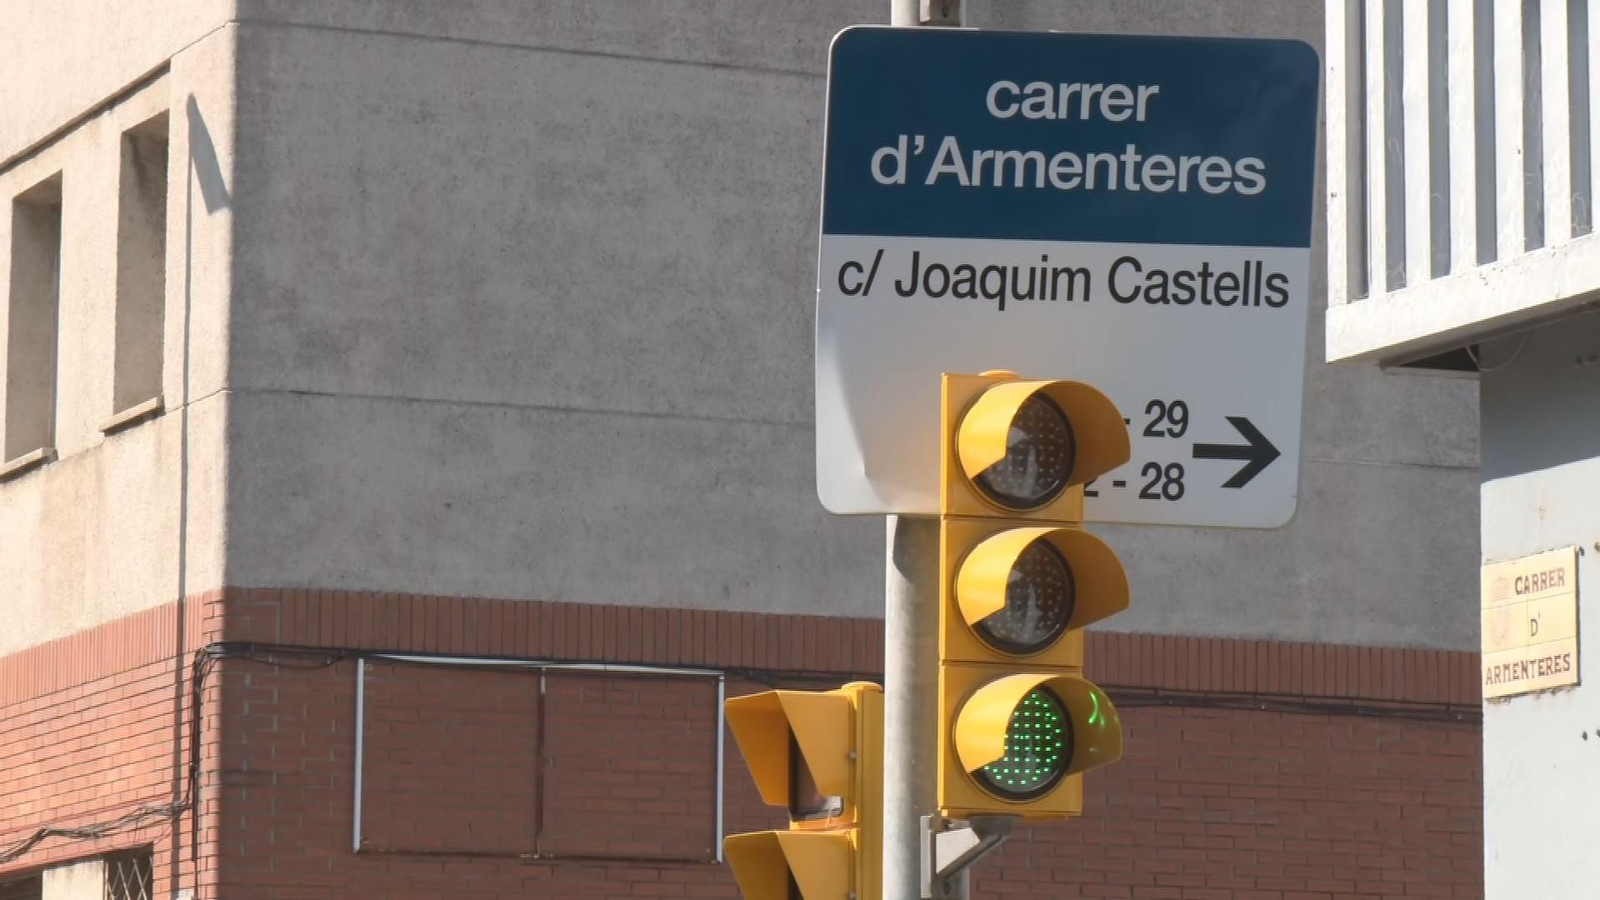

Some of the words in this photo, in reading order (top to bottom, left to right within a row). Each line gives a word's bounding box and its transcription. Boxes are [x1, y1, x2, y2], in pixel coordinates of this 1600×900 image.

[986, 80, 1160, 122] carrer
[870, 134, 1266, 195] d'Armenteres
[838, 249, 885, 297] c/
[894, 250, 1091, 312] Joaquim
[1107, 255, 1290, 308] Castells
[1143, 399, 1189, 438] 29
[1139, 462, 1185, 501] 28
[1515, 567, 1565, 595] CARRER
[1530, 612, 1540, 637] D'
[1485, 653, 1571, 686] ARMENTERES
